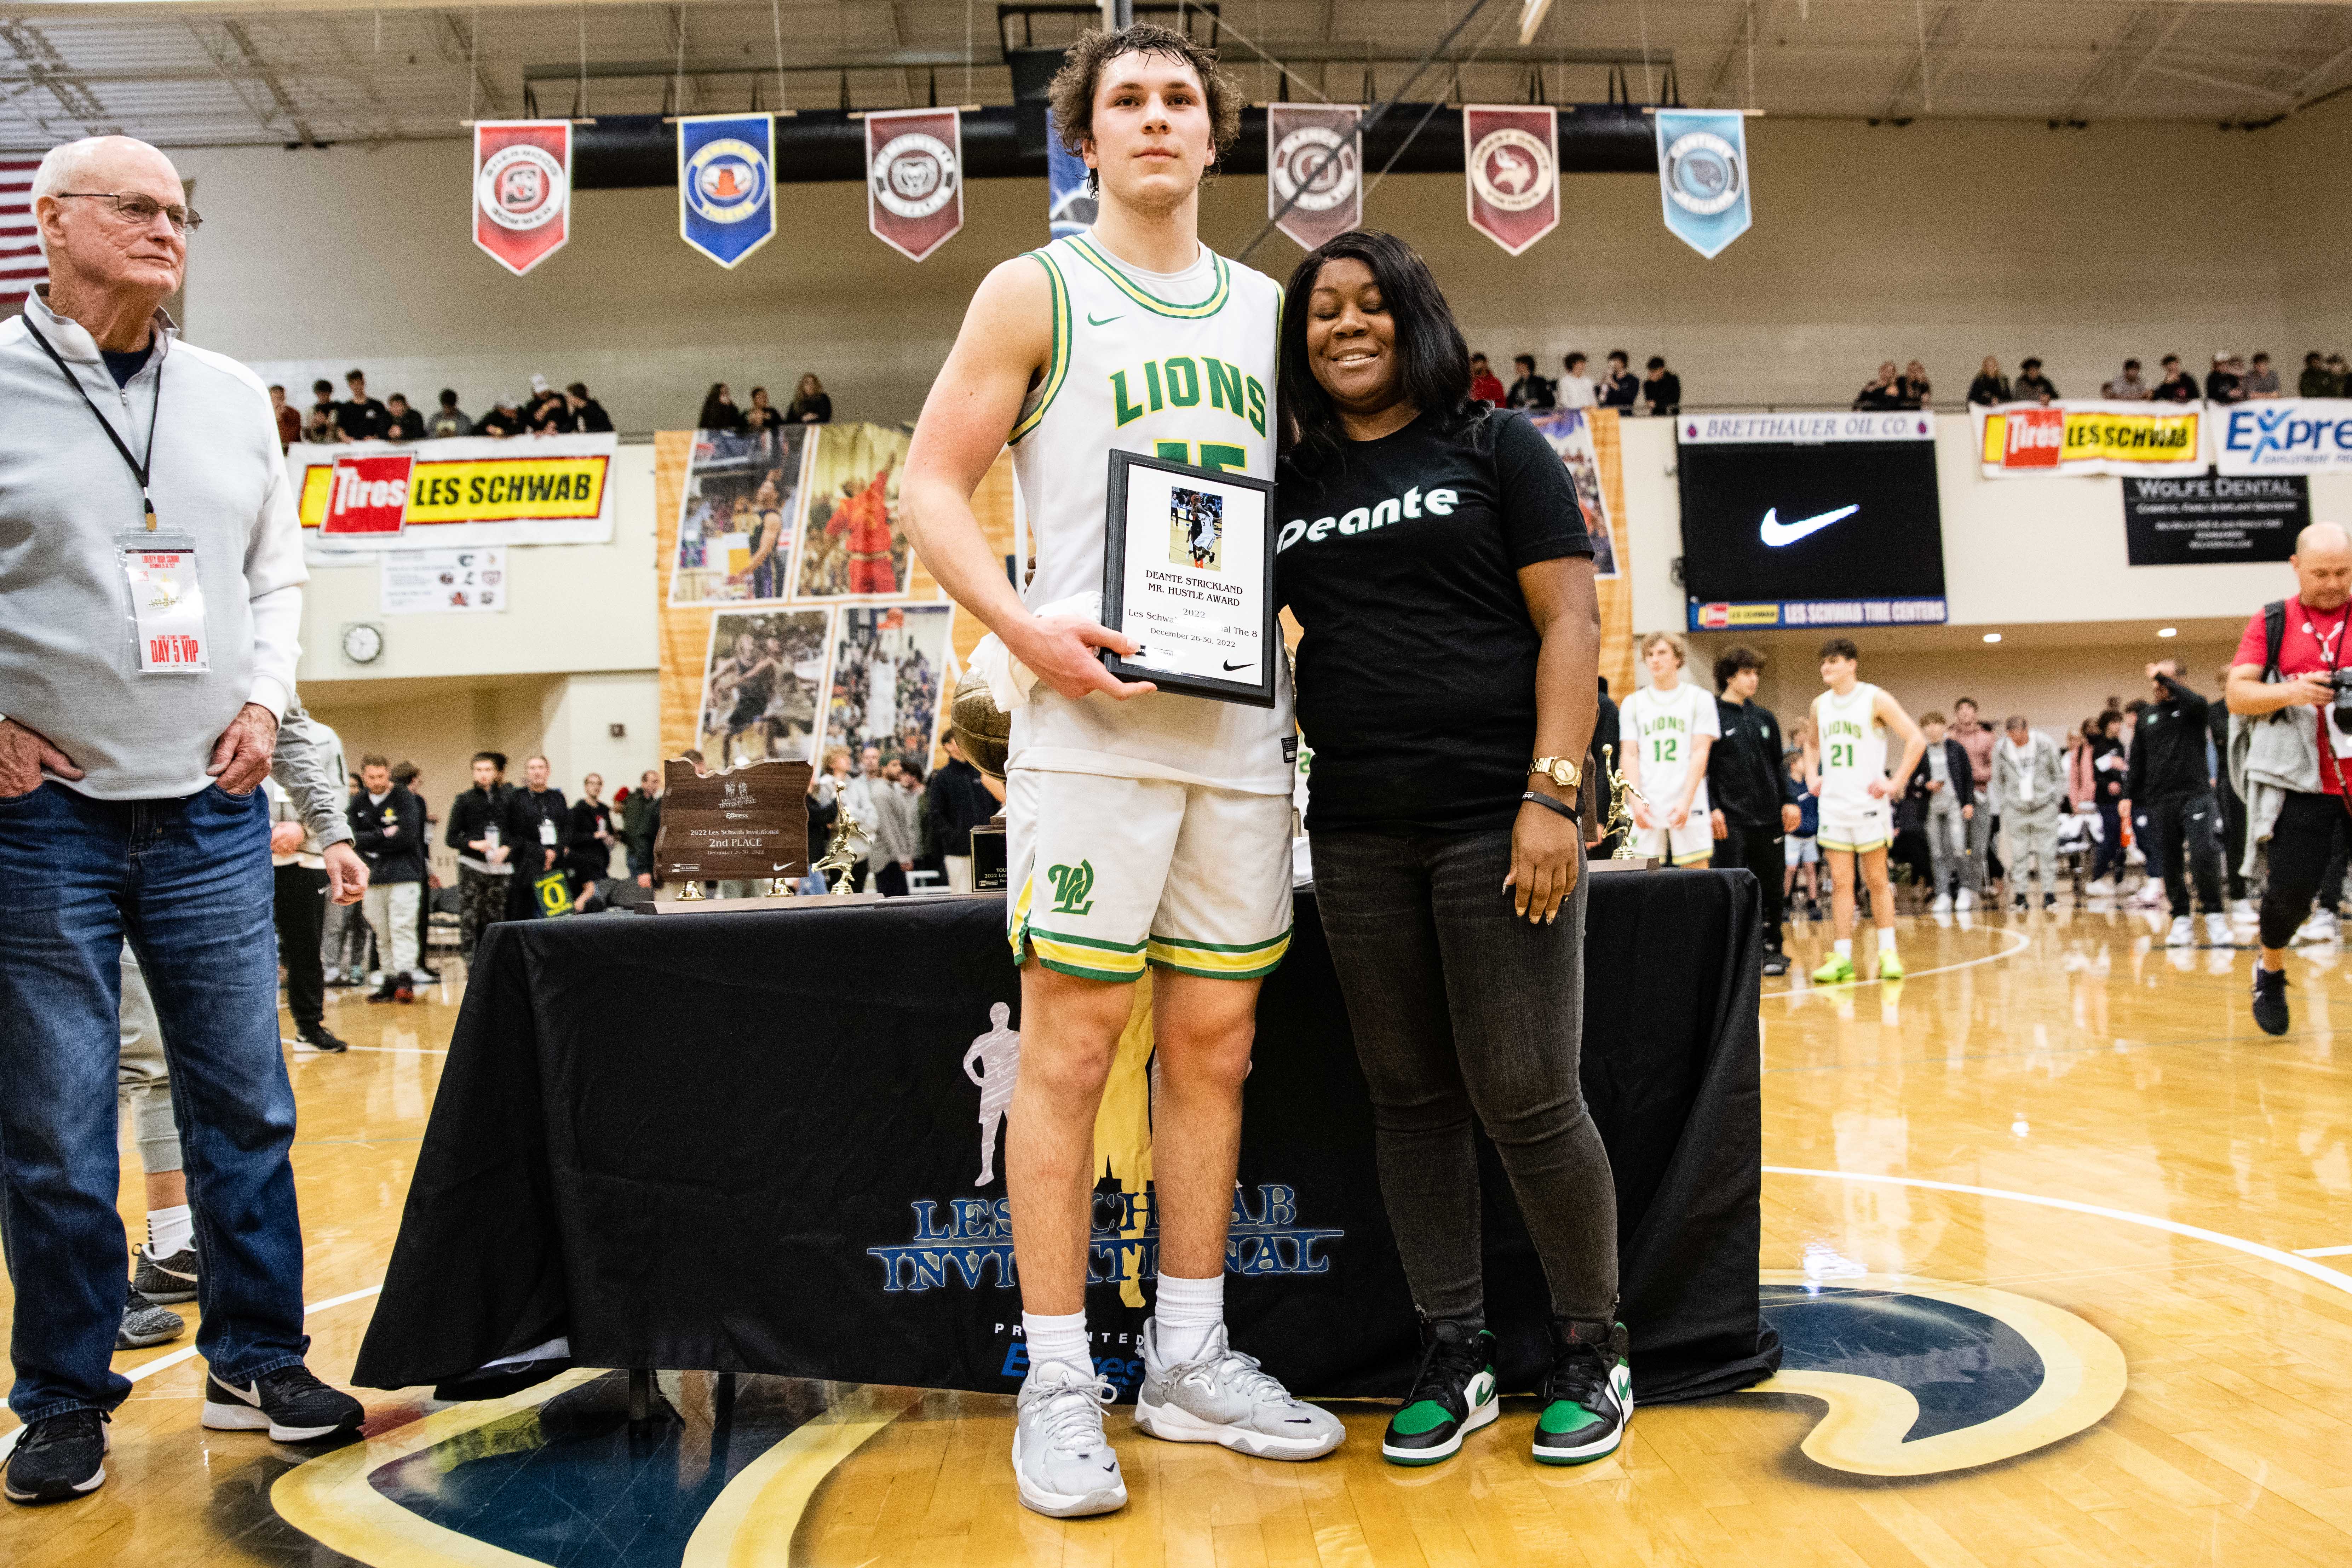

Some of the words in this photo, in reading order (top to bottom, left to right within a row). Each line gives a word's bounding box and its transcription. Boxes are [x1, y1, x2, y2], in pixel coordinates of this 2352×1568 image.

[1109, 356, 1266, 440] LIONS
[1706, 418, 1837, 438] BRETTHAUER
[1846, 418, 1873, 436] OIL
[2009, 414, 2060, 454] Tires
[2067, 424, 2099, 446] LES
[2104, 424, 2187, 448] SCHWAB
[334, 466, 406, 515] Tires
[416, 477, 461, 506] LES
[469, 474, 591, 504] SCHWAB
[2136, 479, 2209, 497] WOLFE
[2215, 478, 2297, 496] DENTAL
[1146, 570, 1183, 584] DEANTE
[1186, 578, 1243, 594] STRICKLAND
[1148, 583, 1164, 593] MR.
[1168, 587, 1204, 600] HUSTLE
[1207, 594, 1240, 606] AWARD
[1128, 609, 1143, 618] Les
[1146, 612, 1177, 623] Schwa
[1233, 627, 1249, 636] The
[1183, 608, 1205, 618] 2022
[1151, 628, 1189, 639] December
[1191, 635, 1214, 644] 26-30,
[1217, 639, 1236, 648] 2022
[150, 640, 169, 662] DAY
[172, 640, 180, 662] 5
[181, 640, 198, 662] VIP
[1644, 716, 1685, 735] LIONS
[1654, 739, 1677, 762] 12
[1831, 744, 1853, 766] 21
[709, 838, 728, 847] 2nd
[731, 838, 762, 847] PLACE
